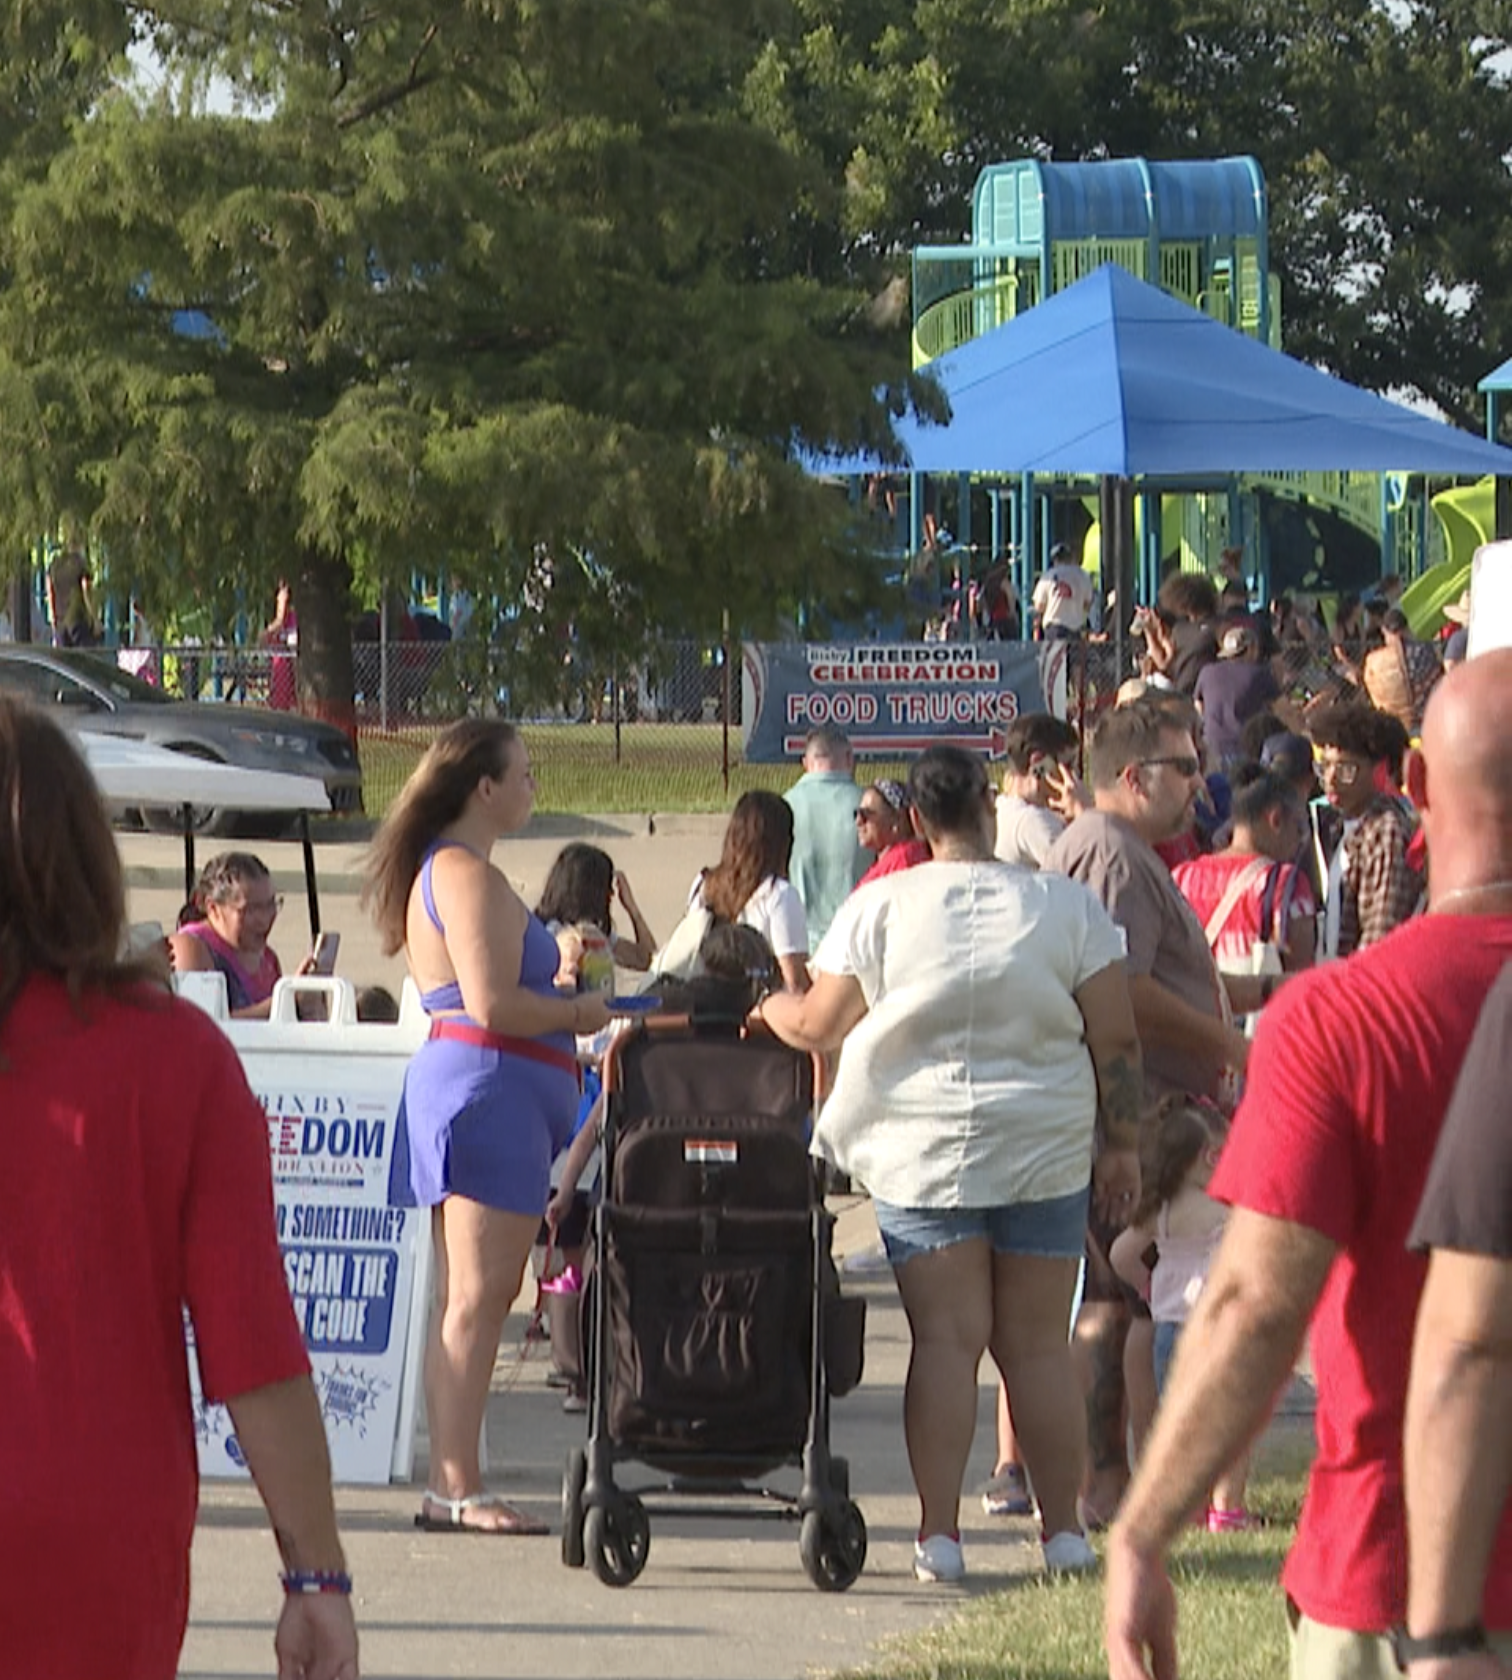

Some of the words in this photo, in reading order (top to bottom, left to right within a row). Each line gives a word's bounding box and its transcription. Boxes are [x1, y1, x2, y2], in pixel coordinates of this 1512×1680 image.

[813, 664, 997, 682] CELEBRATION
[857, 649, 975, 663] FREEDOM
[787, 692, 878, 724] FOOD
[886, 690, 1018, 724] TRUCKS
[291, 1204, 406, 1243] SOMETHING?
[283, 1251, 347, 1298] SCAN
[350, 1254, 390, 1298] THE
[312, 1298, 369, 1342] CODE
